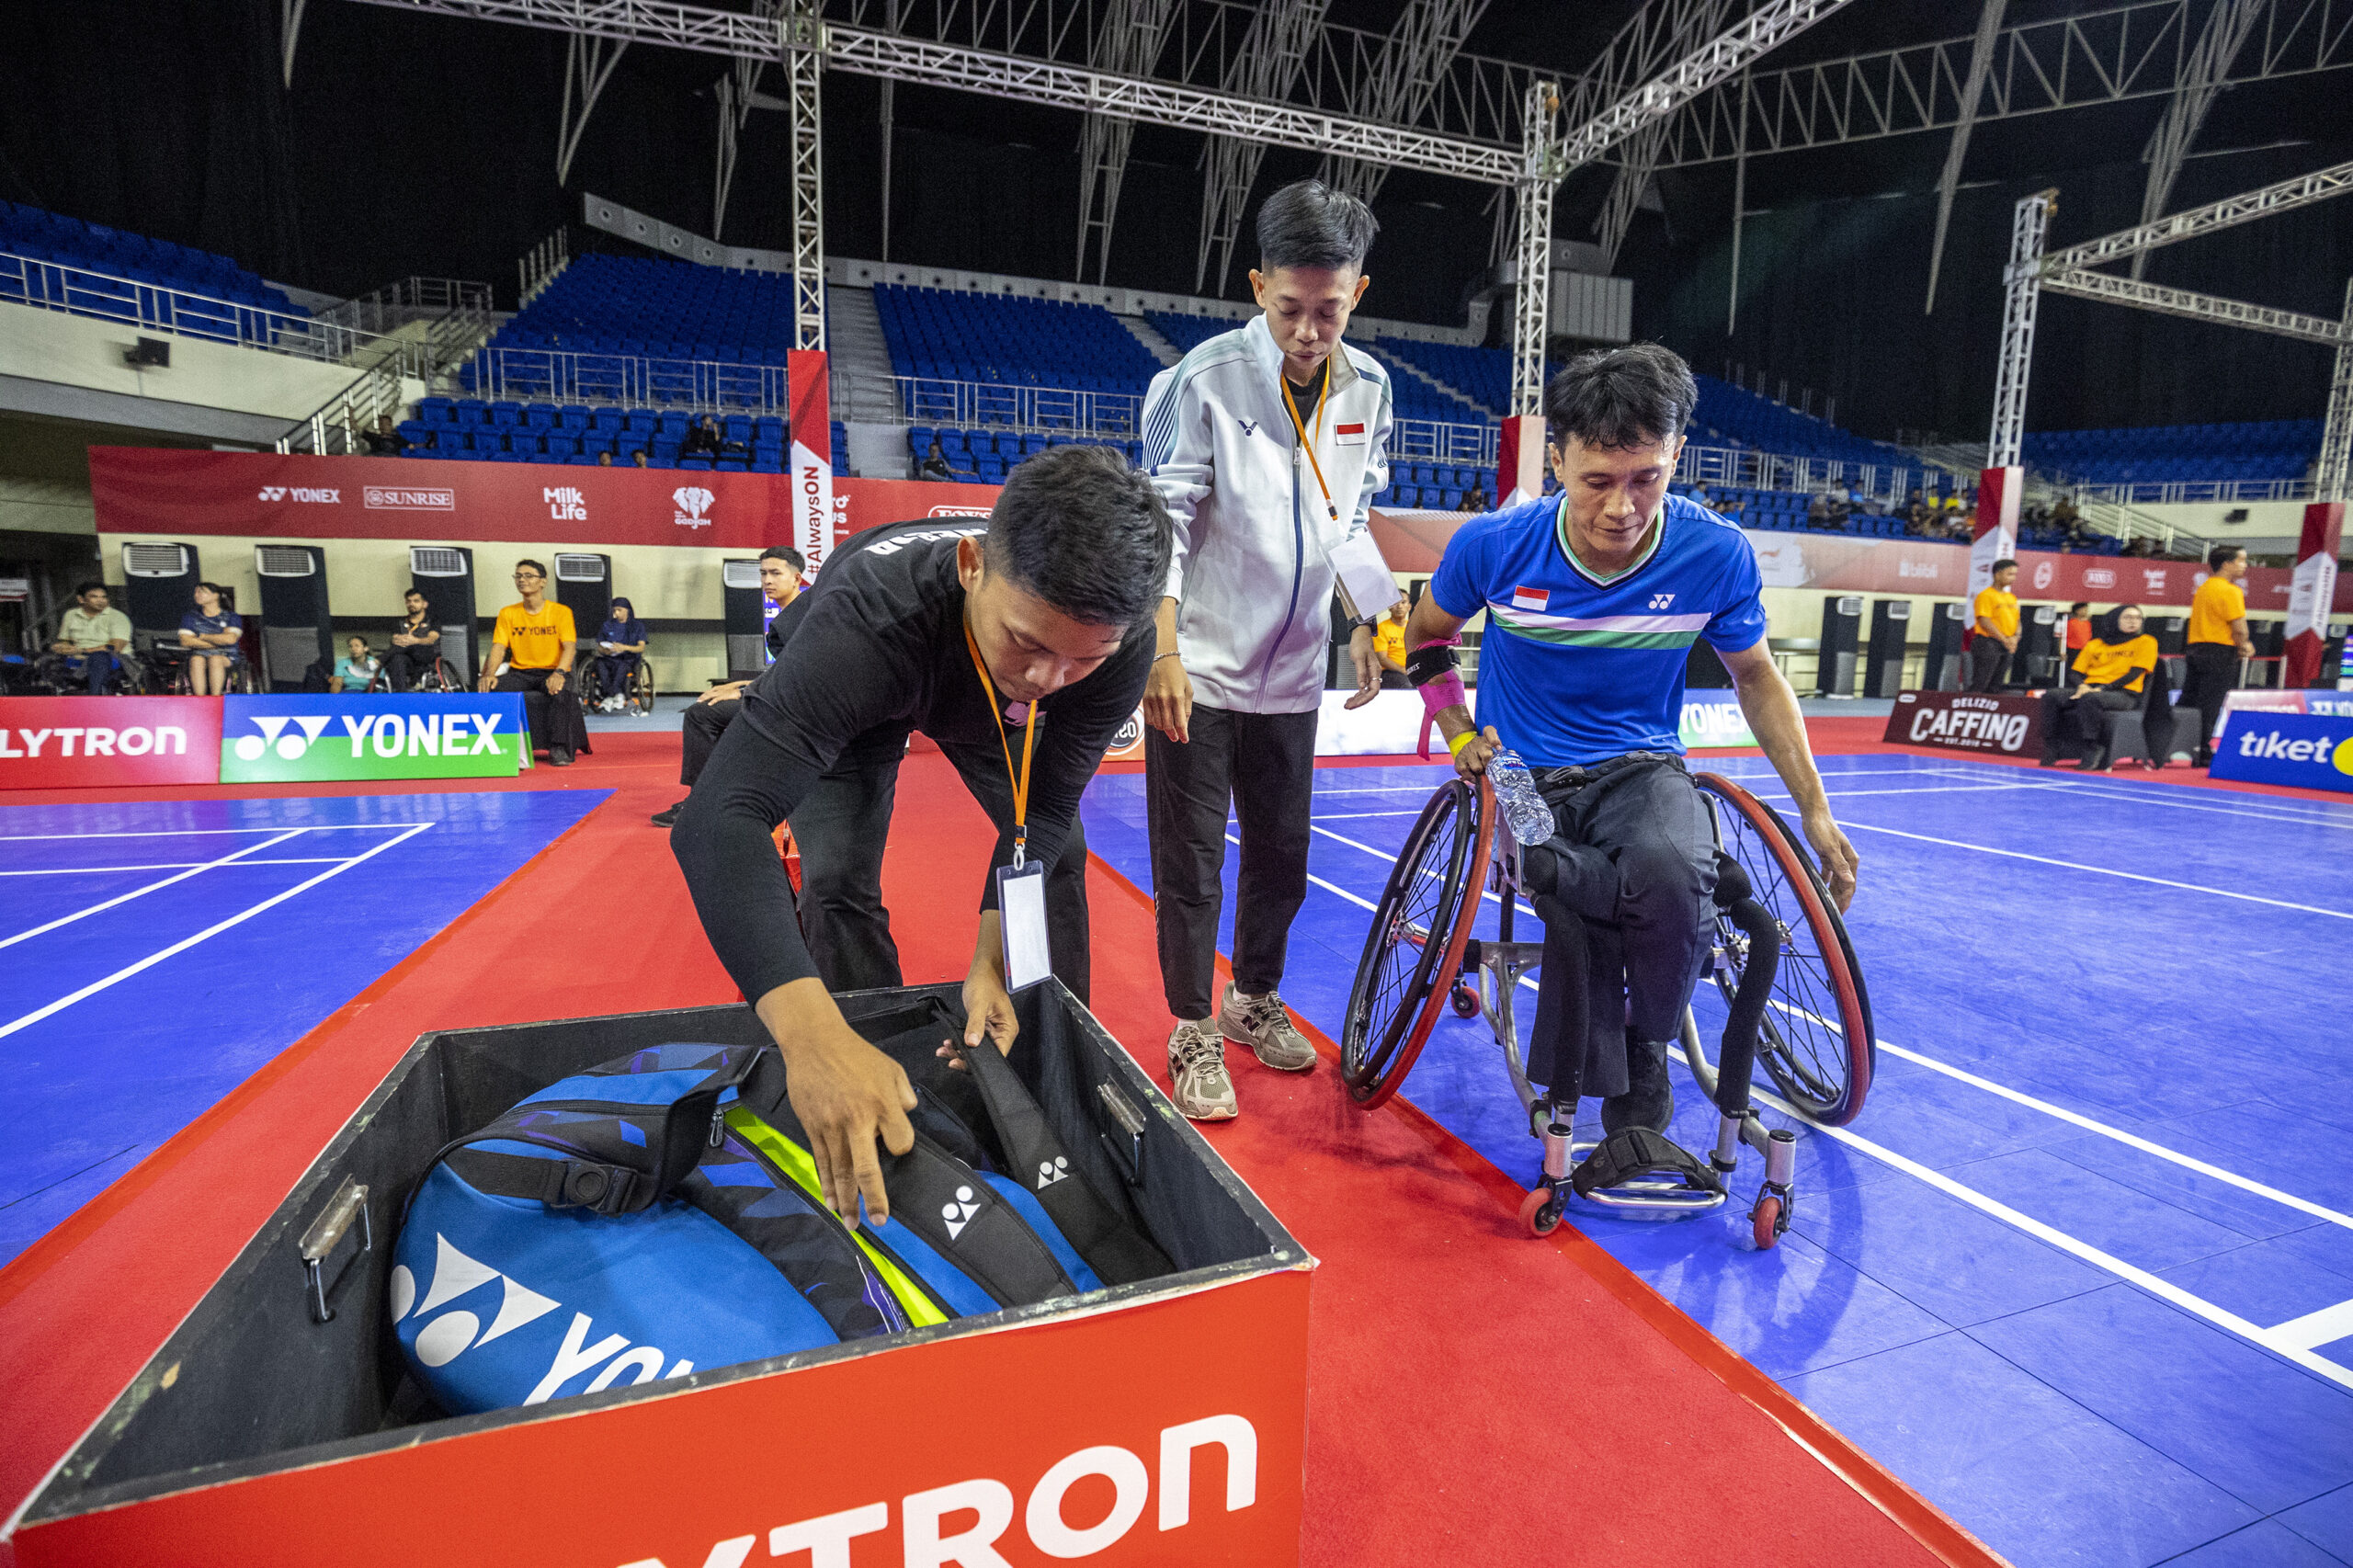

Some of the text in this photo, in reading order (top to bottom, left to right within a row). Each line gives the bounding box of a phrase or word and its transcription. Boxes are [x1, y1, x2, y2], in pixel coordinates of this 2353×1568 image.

[290, 488, 341, 504] YONEX
[384, 492, 450, 506] SUNRISE
[543, 487, 585, 505] Milk
[551, 504, 587, 520] Life
[529, 625, 557, 636] YONEX
[1951, 698, 1999, 711] DELIZIO
[341, 713, 503, 758] YONEX
[1909, 708, 2029, 751] CAFFINO
[2239, 730, 2333, 764] tiket
